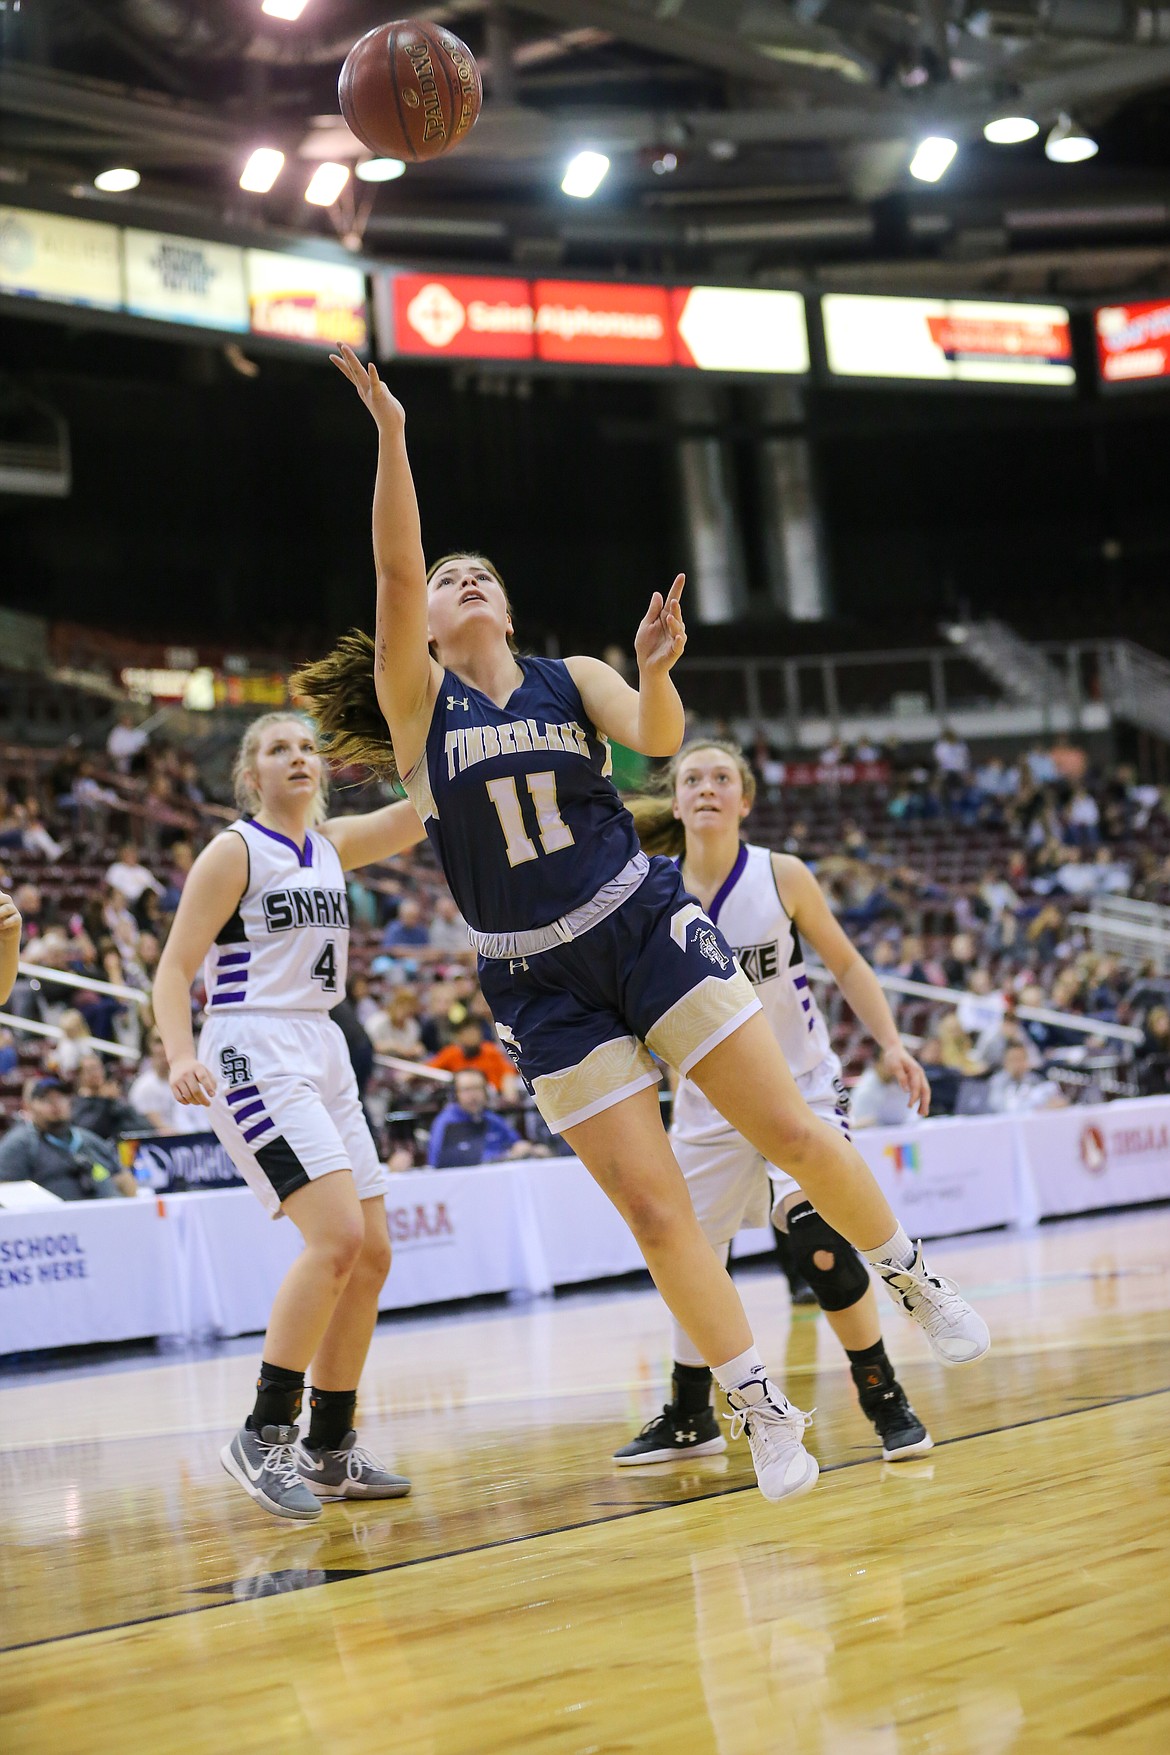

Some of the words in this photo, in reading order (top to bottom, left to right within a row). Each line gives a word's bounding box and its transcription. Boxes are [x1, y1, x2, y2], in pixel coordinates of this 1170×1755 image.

[405, 43, 447, 143] SPALDING
[485, 770, 576, 868] 11
[311, 939, 337, 992] 4
[0, 1234, 84, 1262] SCHOOL
[38, 1260, 88, 1284] HERE
